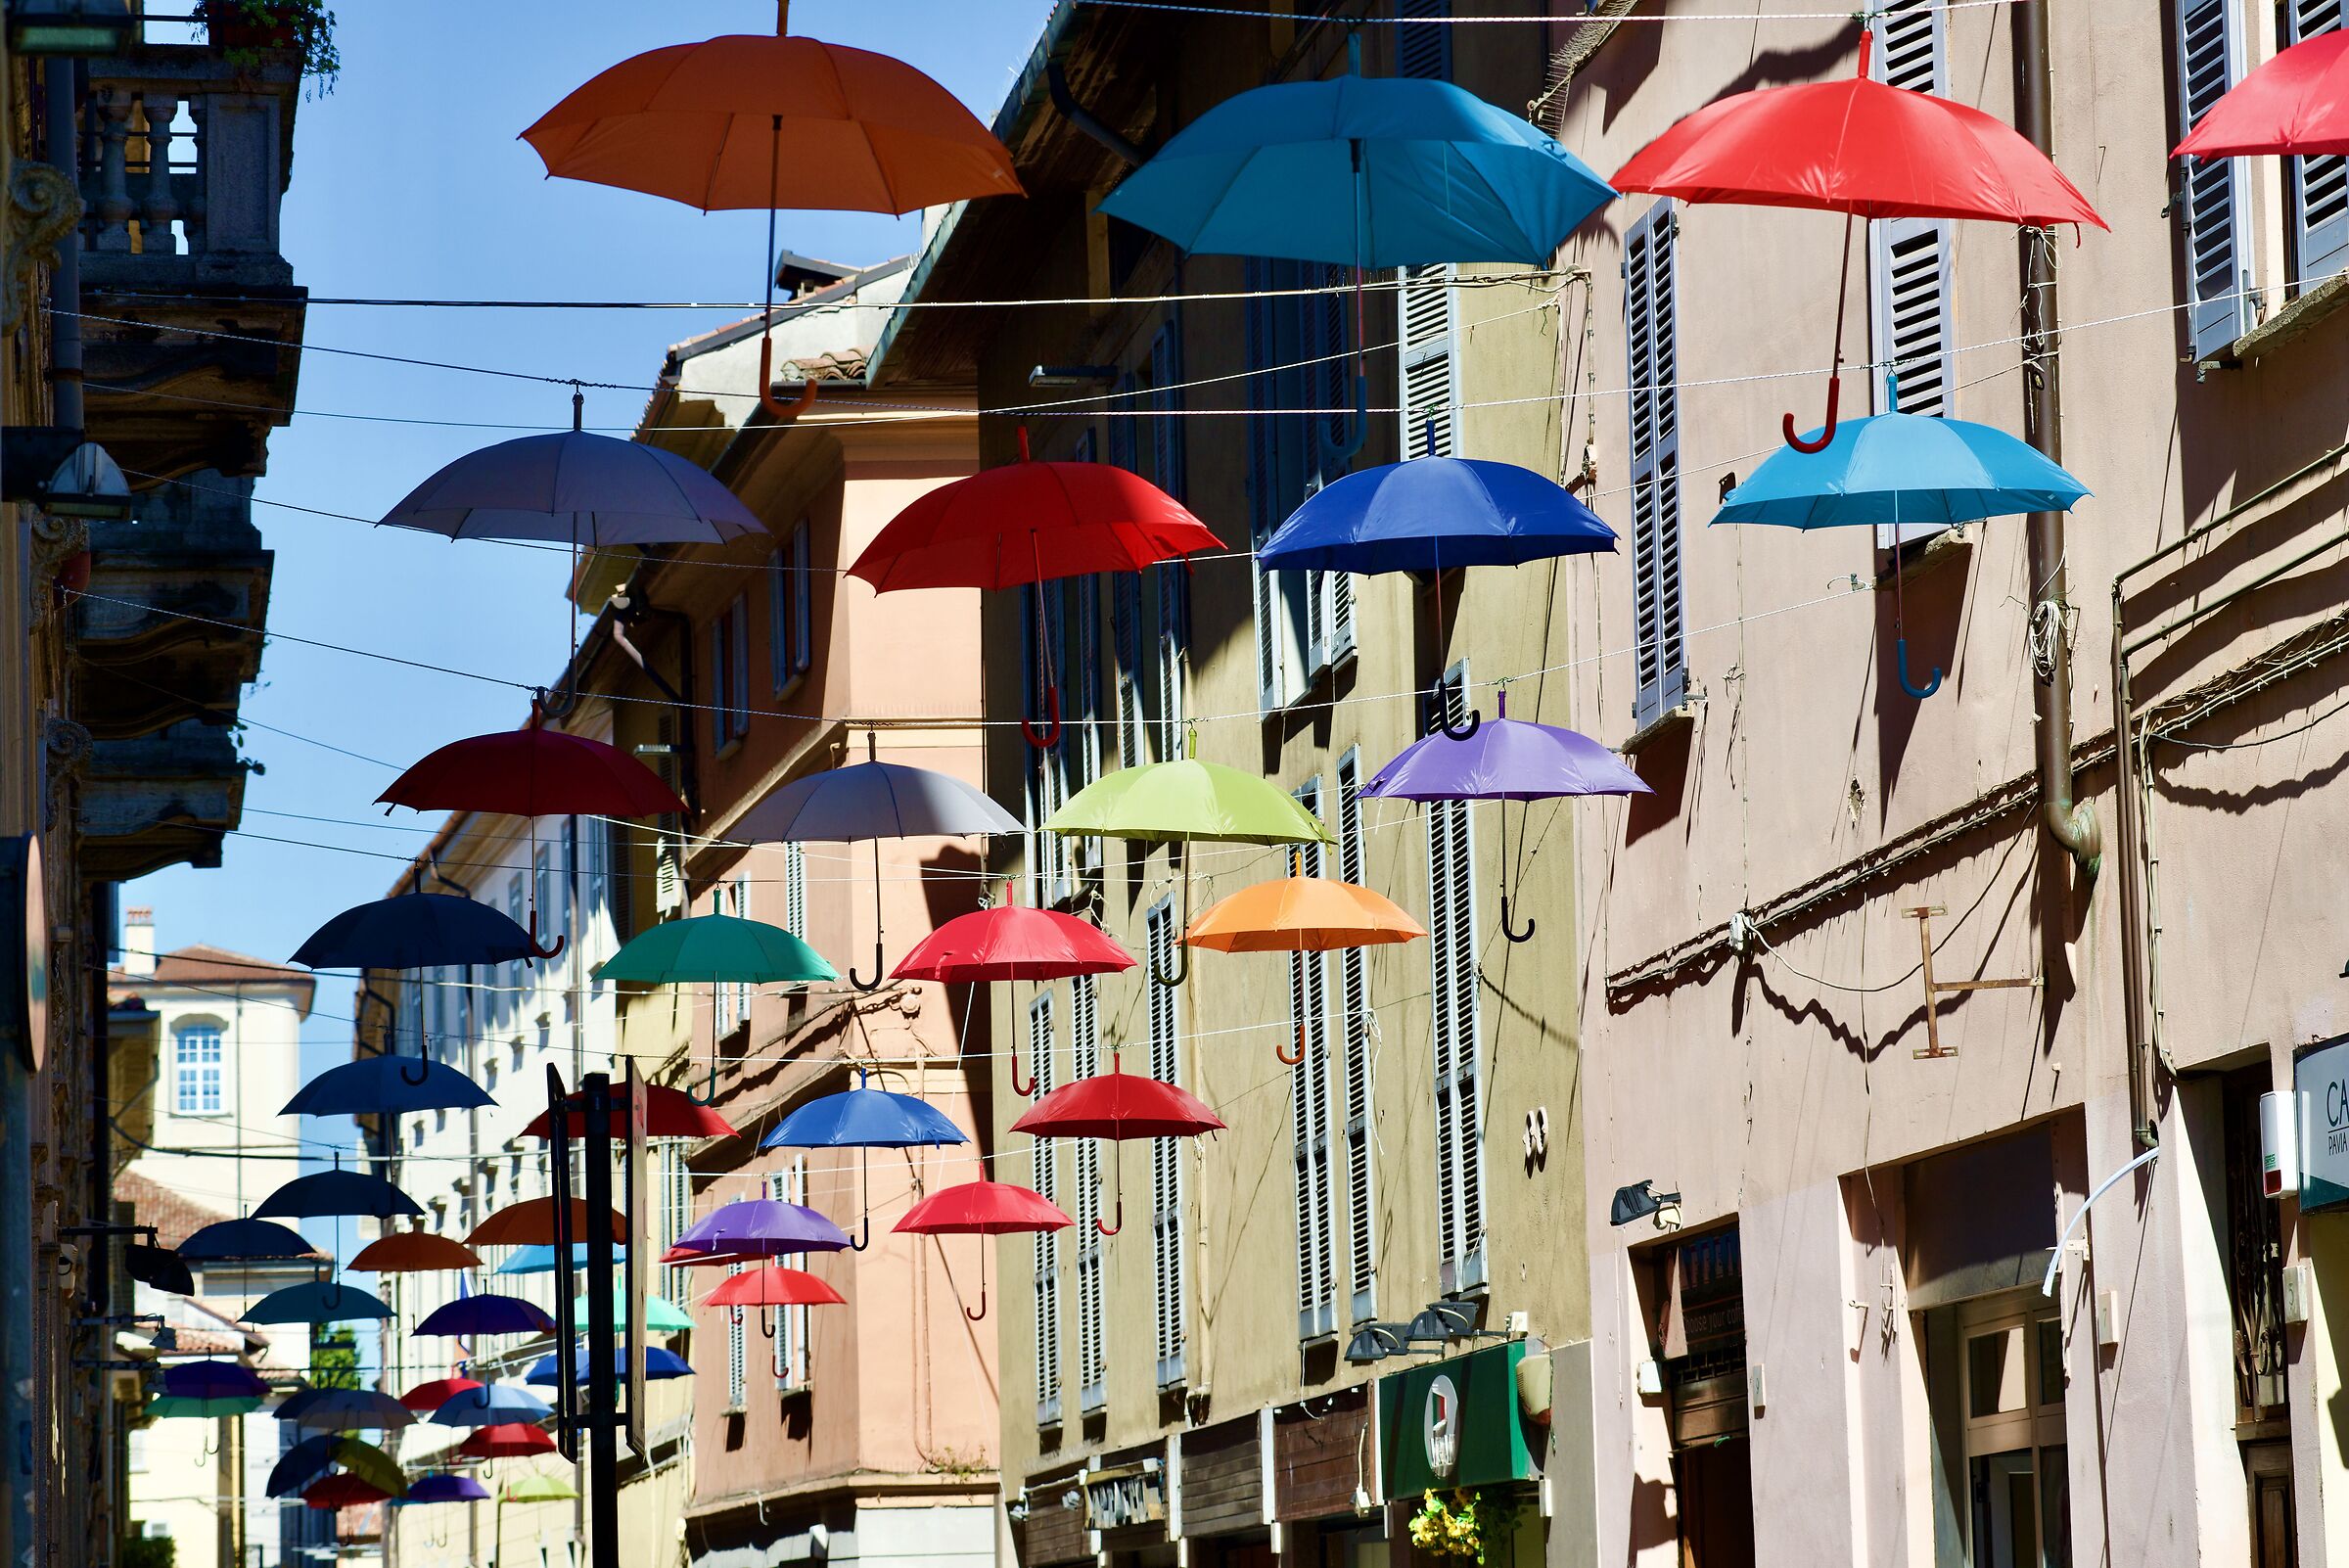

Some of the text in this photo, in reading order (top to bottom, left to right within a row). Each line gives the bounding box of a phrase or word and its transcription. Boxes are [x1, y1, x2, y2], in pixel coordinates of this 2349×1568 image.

[2326, 1079, 2349, 1127] CA
[2328, 1132, 2348, 1156] PAVIA
[2288, 1282, 2294, 1306] 5
[1709, 1311, 1726, 1332] your
